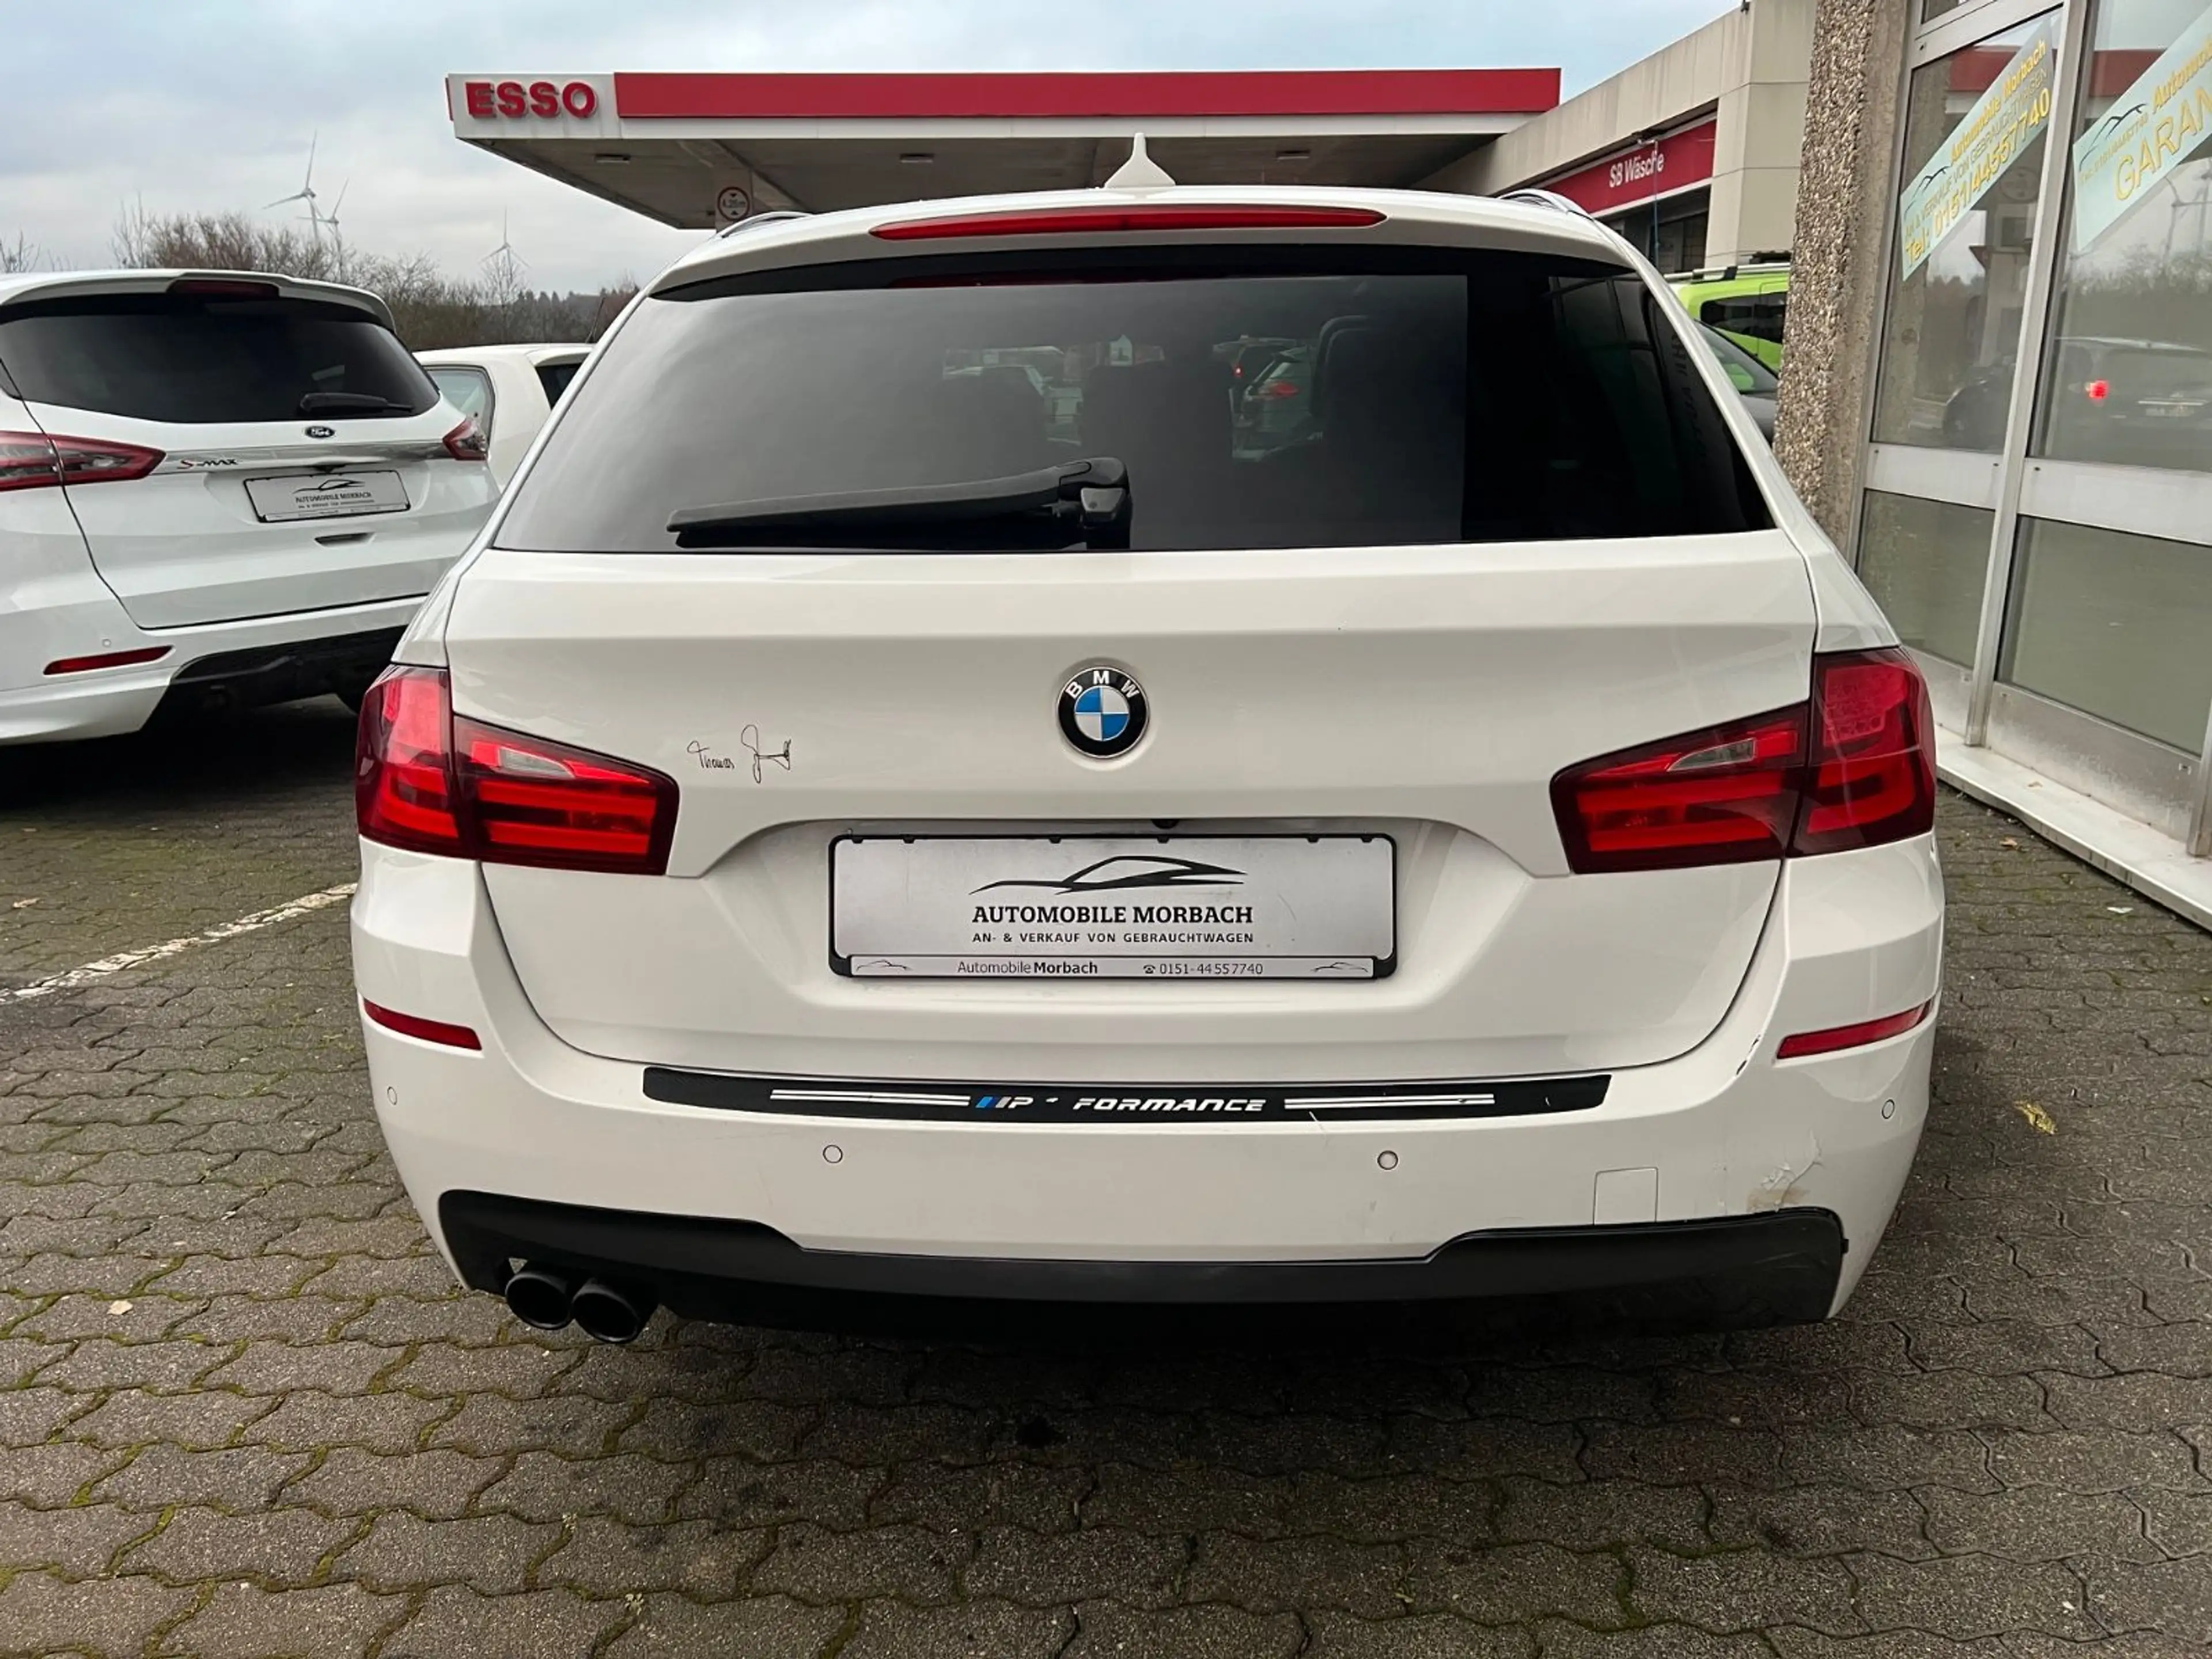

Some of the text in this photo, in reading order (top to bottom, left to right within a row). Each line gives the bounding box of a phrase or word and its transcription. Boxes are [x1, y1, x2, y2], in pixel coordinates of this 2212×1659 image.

[465, 81, 597, 119] ESSO
[1952, 39, 2046, 165] Automobile Morbach
[1609, 150, 1664, 187] SB Wäsche
[1065, 671, 1140, 699] BMW
[972, 906, 1253, 923] AUTOMOBILE MORBACH
[972, 933, 1253, 943] AN- & VERKAUF VON GEBRAUCHTWAGEN
[957, 961, 1263, 975] Automobile Morbach 0151-44557740
